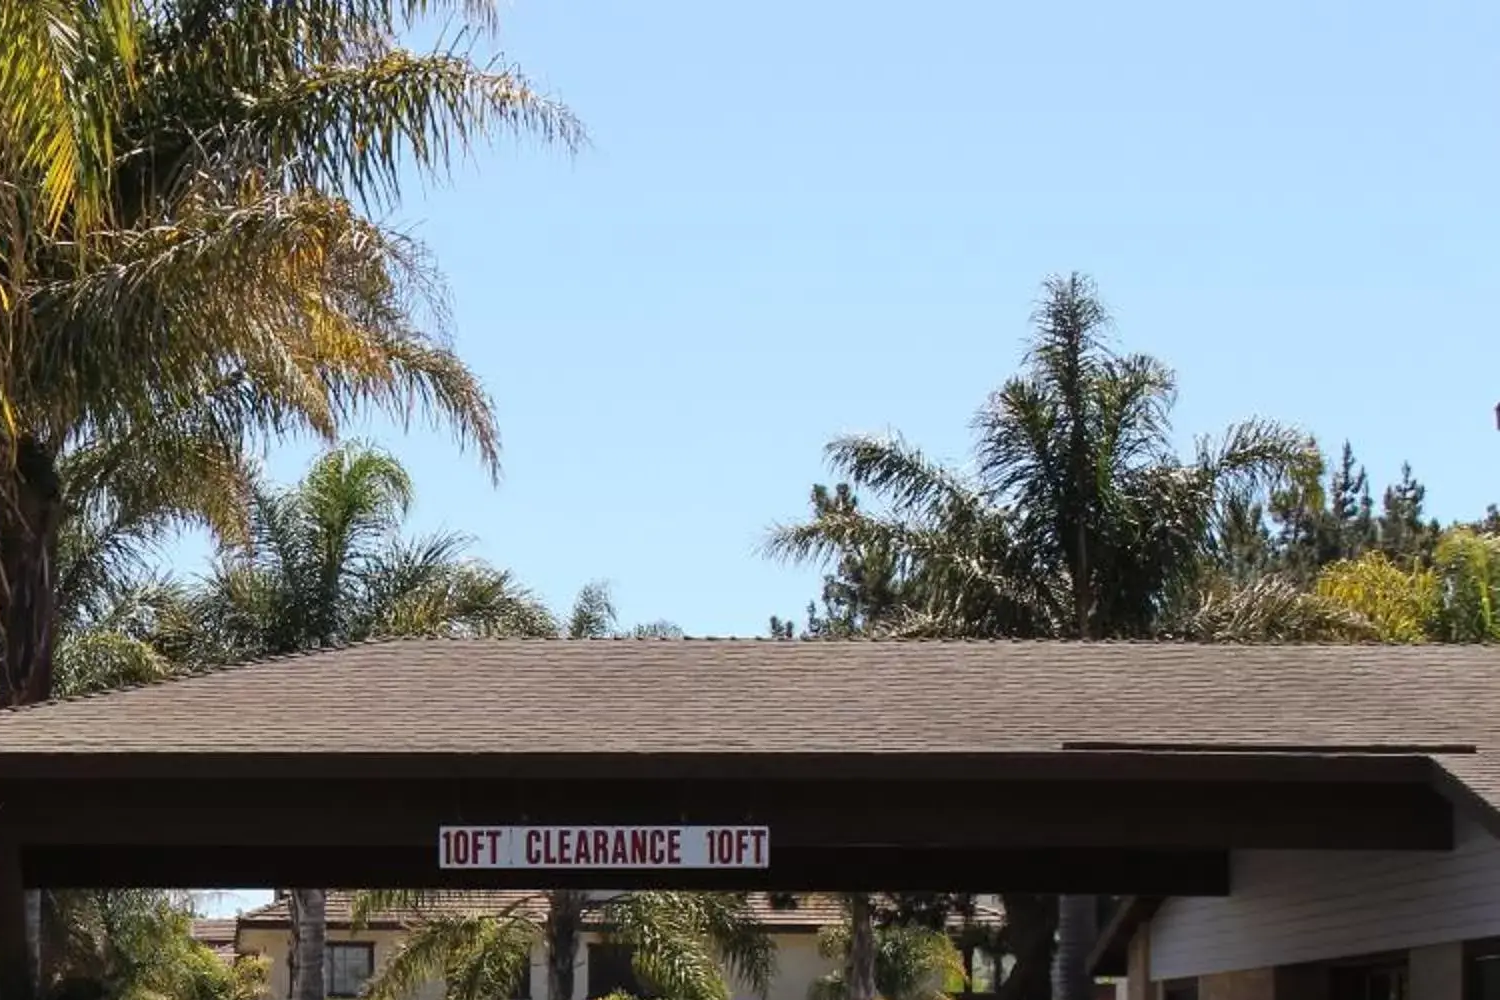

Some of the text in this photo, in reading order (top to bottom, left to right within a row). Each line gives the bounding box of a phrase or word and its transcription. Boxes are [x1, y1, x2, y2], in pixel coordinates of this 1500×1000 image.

[442, 829, 767, 865] 10FT CLEARANCE 10FT
